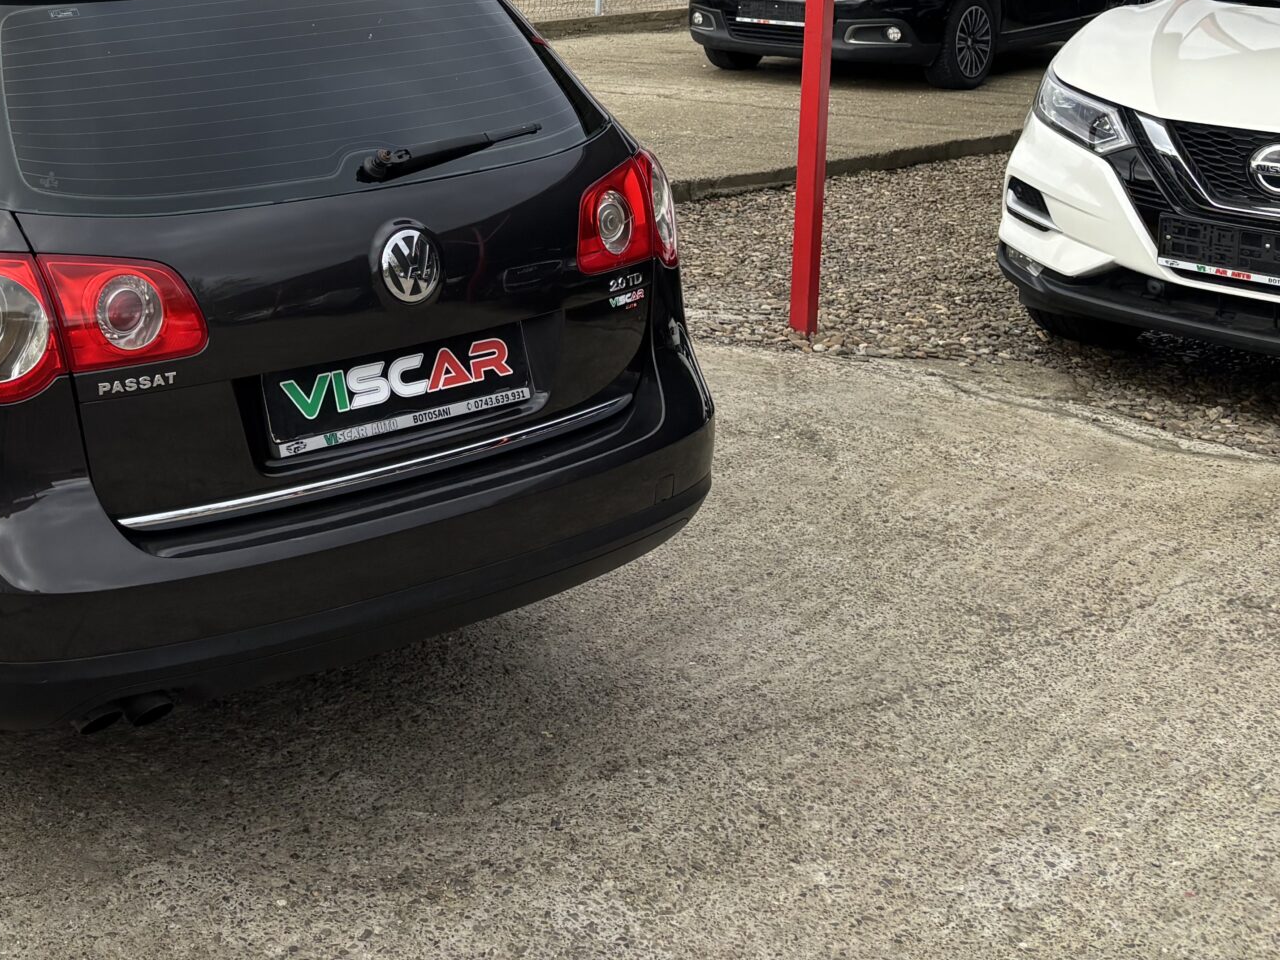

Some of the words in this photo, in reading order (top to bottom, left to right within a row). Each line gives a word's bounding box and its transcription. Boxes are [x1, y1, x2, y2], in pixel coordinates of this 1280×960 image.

[1196, 265, 1228, 277] VIAR
[609, 288, 645, 308] VISCAR
[98, 371, 177, 395] PASSAT
[280, 337, 514, 420] VISCAR
[324, 426, 368, 446] VISCAR
[371, 419, 399, 436] AUTO
[412, 407, 452, 424] BOTOSANI
[474, 389, 526, 409] 0743.639.931
